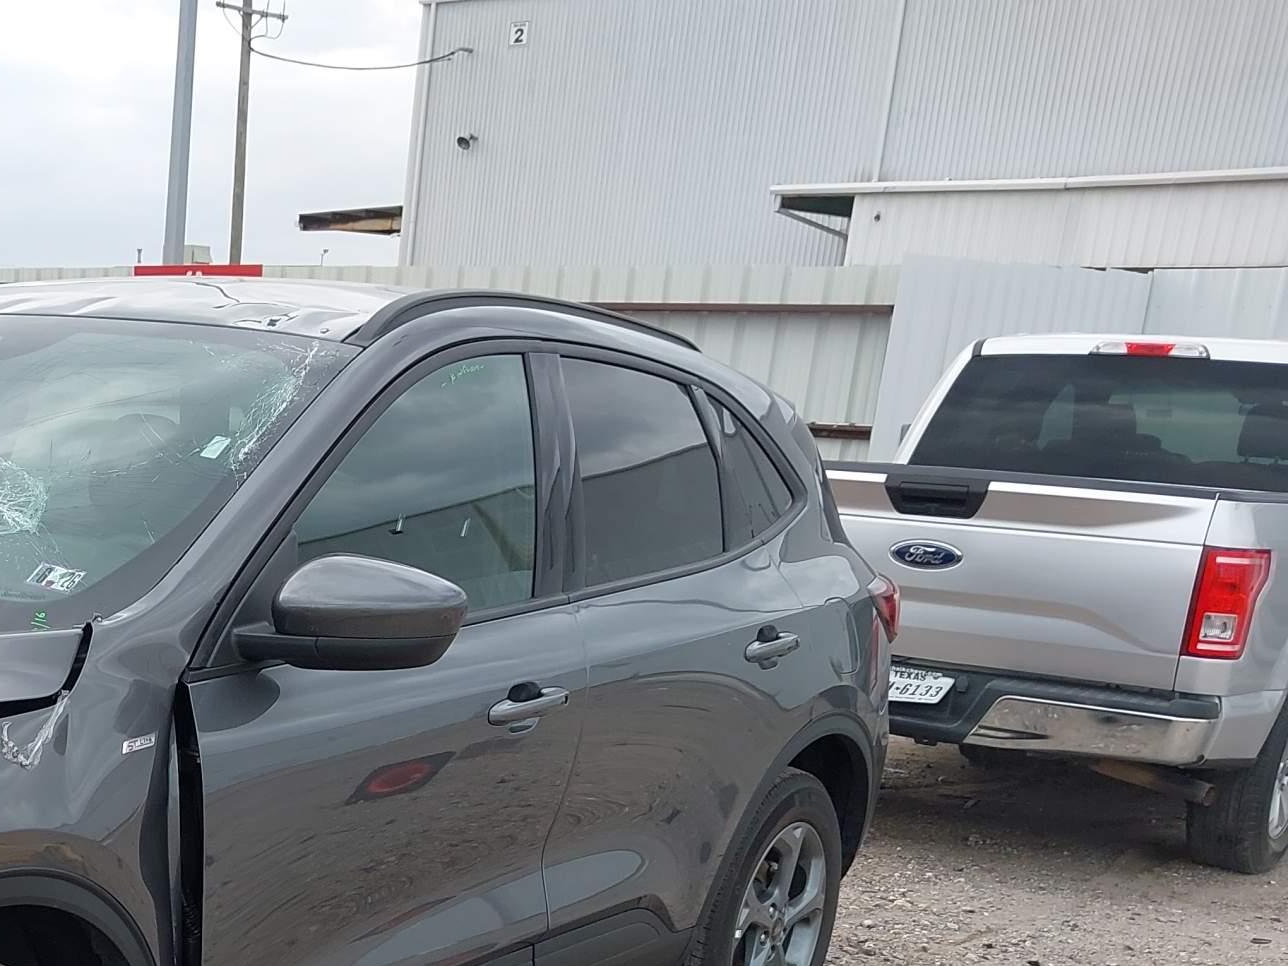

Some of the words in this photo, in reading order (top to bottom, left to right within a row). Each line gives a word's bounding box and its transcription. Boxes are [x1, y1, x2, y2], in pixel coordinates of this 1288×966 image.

[513, 28, 524, 43] 2
[905, 546, 945, 564] Ford
[894, 671, 926, 681] TEXAS
